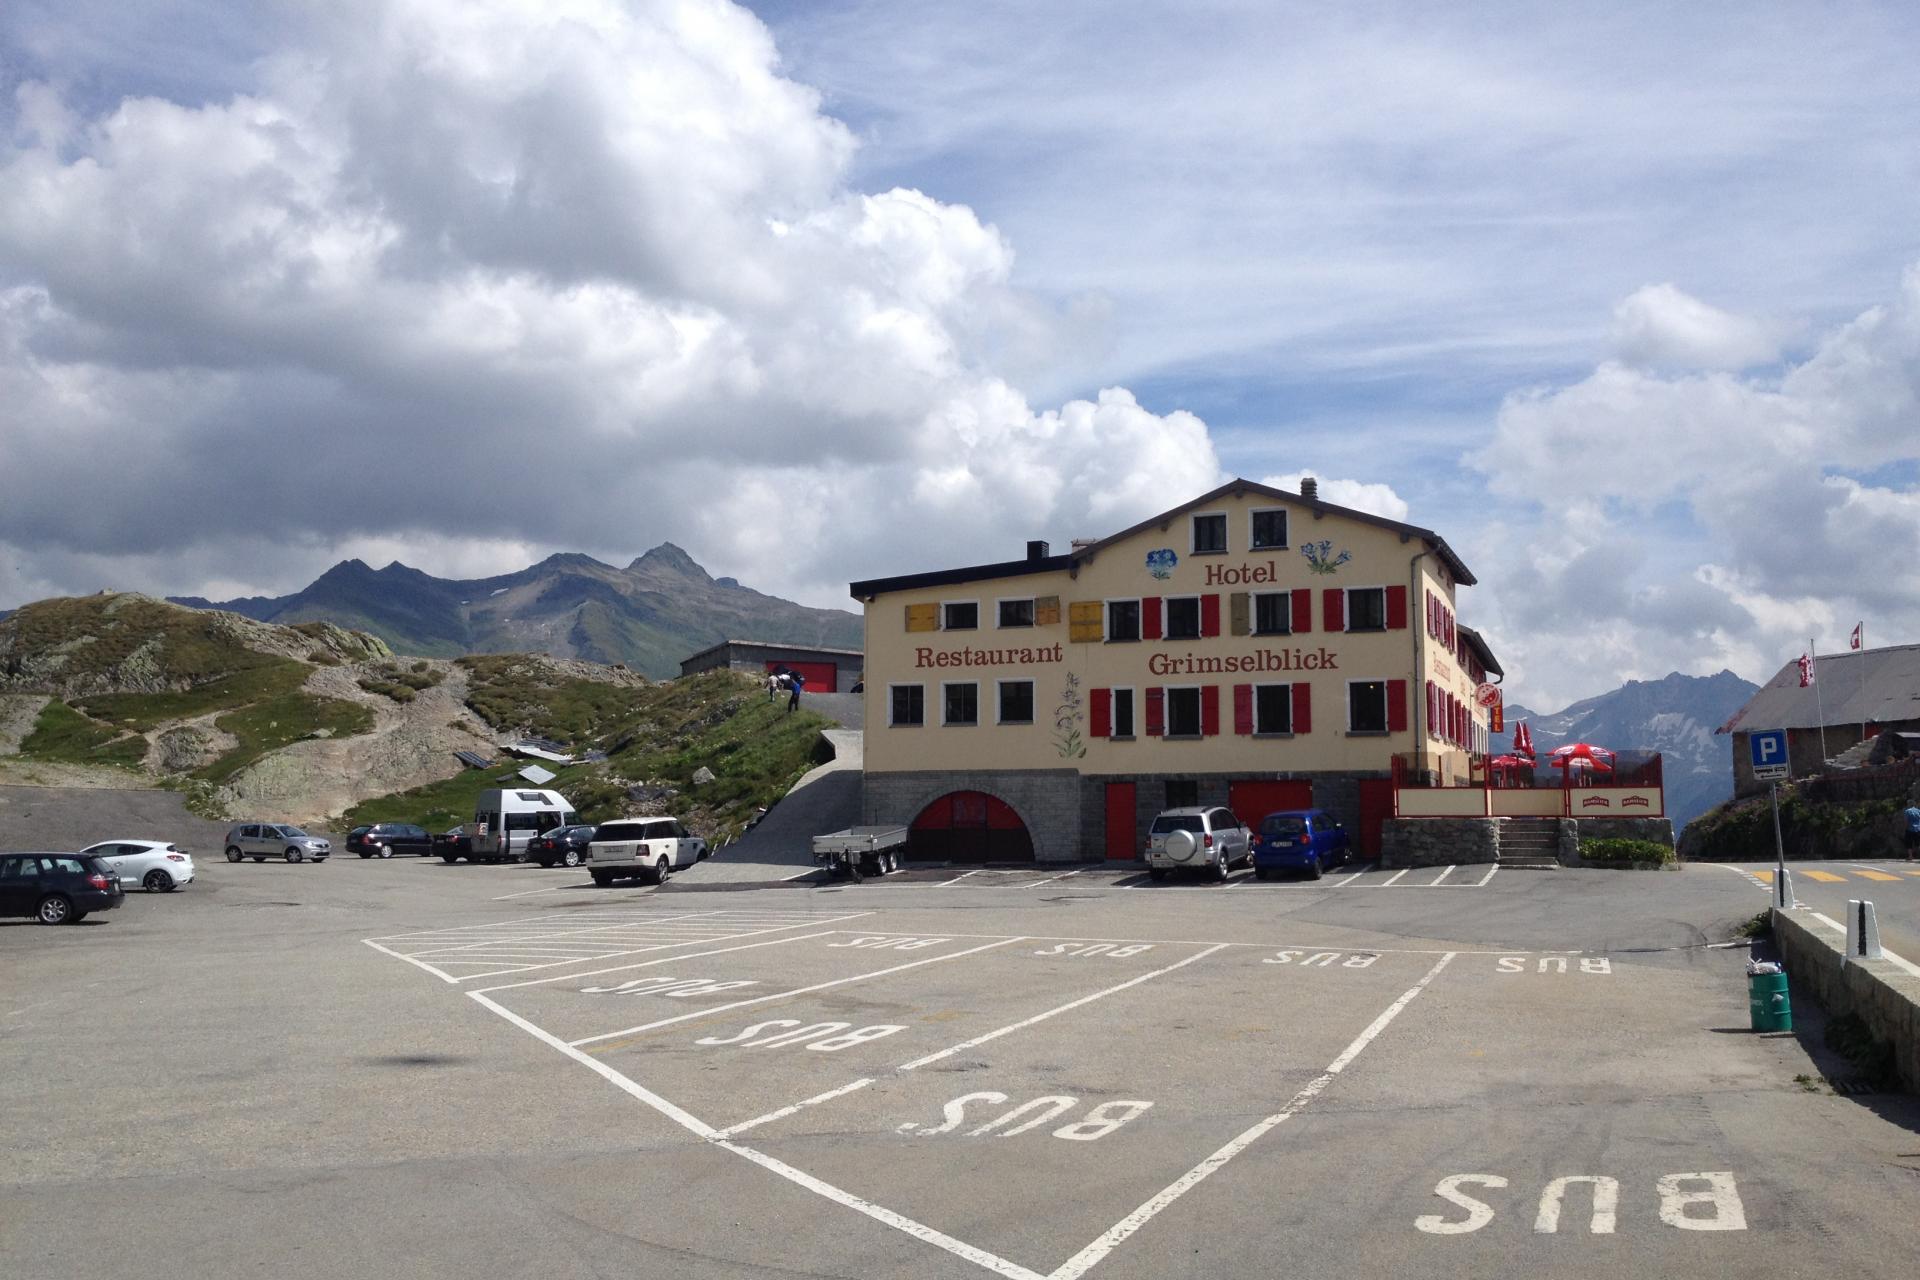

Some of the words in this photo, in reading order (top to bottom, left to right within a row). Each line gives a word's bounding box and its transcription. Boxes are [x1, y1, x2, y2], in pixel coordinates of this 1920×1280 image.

[1205, 561, 1277, 586] Hotel
[915, 642, 1063, 668] Restaurant
[1148, 648, 1339, 675] Grimselblick
[1760, 737, 1777, 761] P
[827, 937, 952, 950] BUS
[1034, 943, 1155, 957] BUS
[1262, 950, 1382, 968] BUS
[1496, 957, 1612, 975] BUS
[580, 977, 759, 997] BUS
[695, 1020, 909, 1051] BUS
[895, 1092, 1154, 1140] BUS
[1413, 1171, 1747, 1234] BUS
